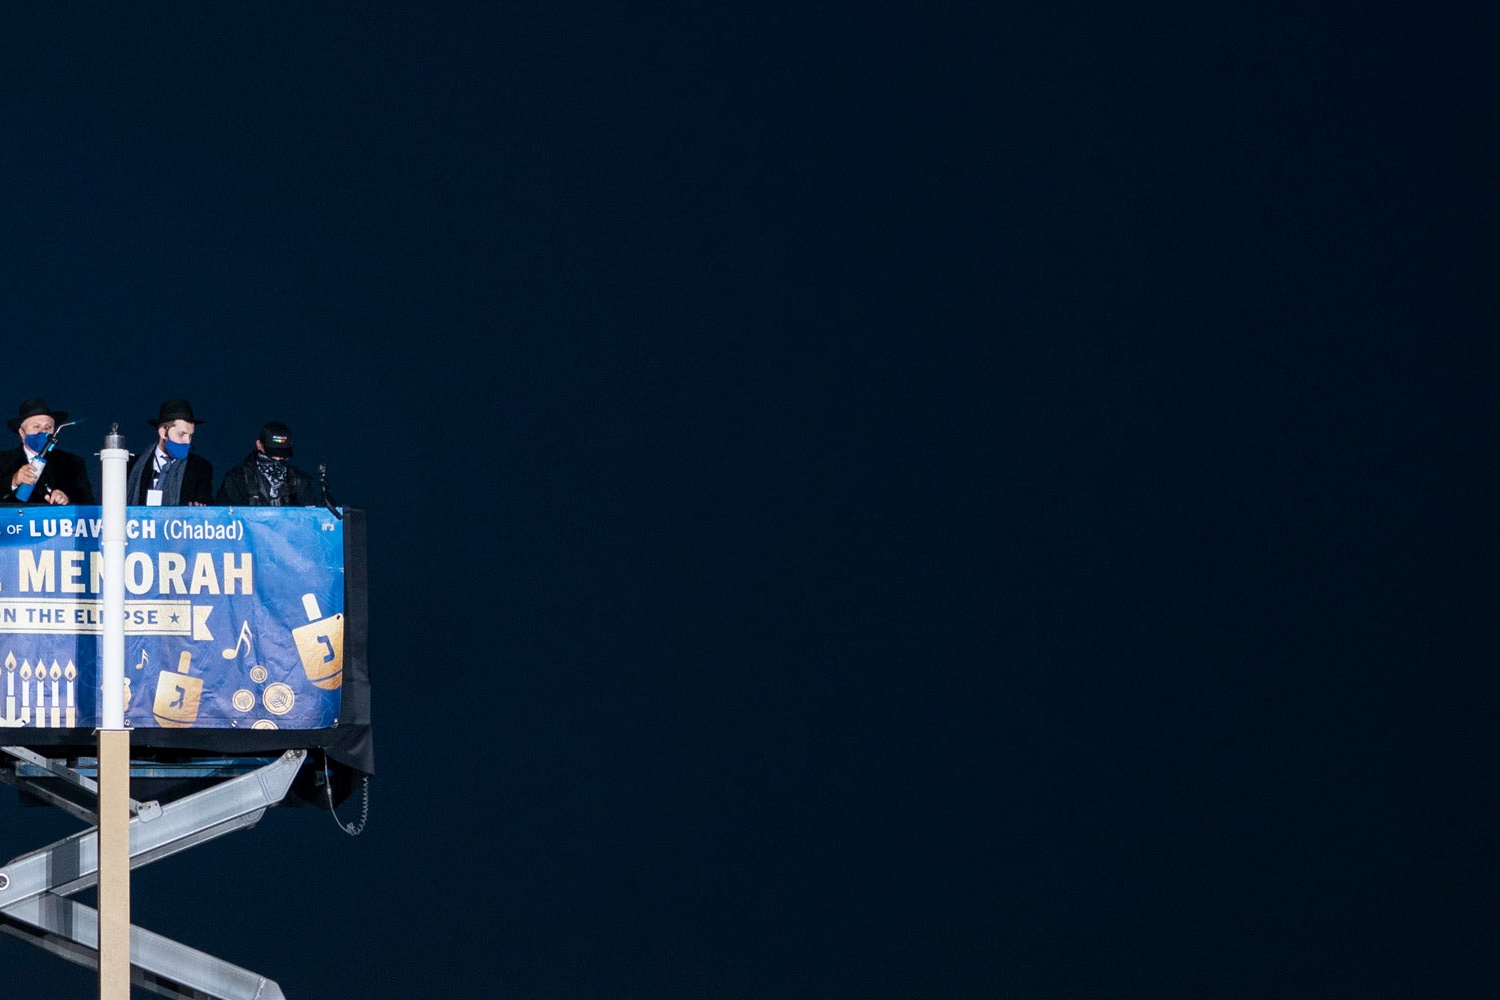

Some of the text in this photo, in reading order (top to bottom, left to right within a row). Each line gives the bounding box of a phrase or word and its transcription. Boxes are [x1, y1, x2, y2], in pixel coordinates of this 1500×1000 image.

[6, 525, 24, 535] OF
[29, 518, 156, 539] LUBAVCH
[163, 520, 244, 541] (Chabad)
[26, 608, 65, 623] THE
